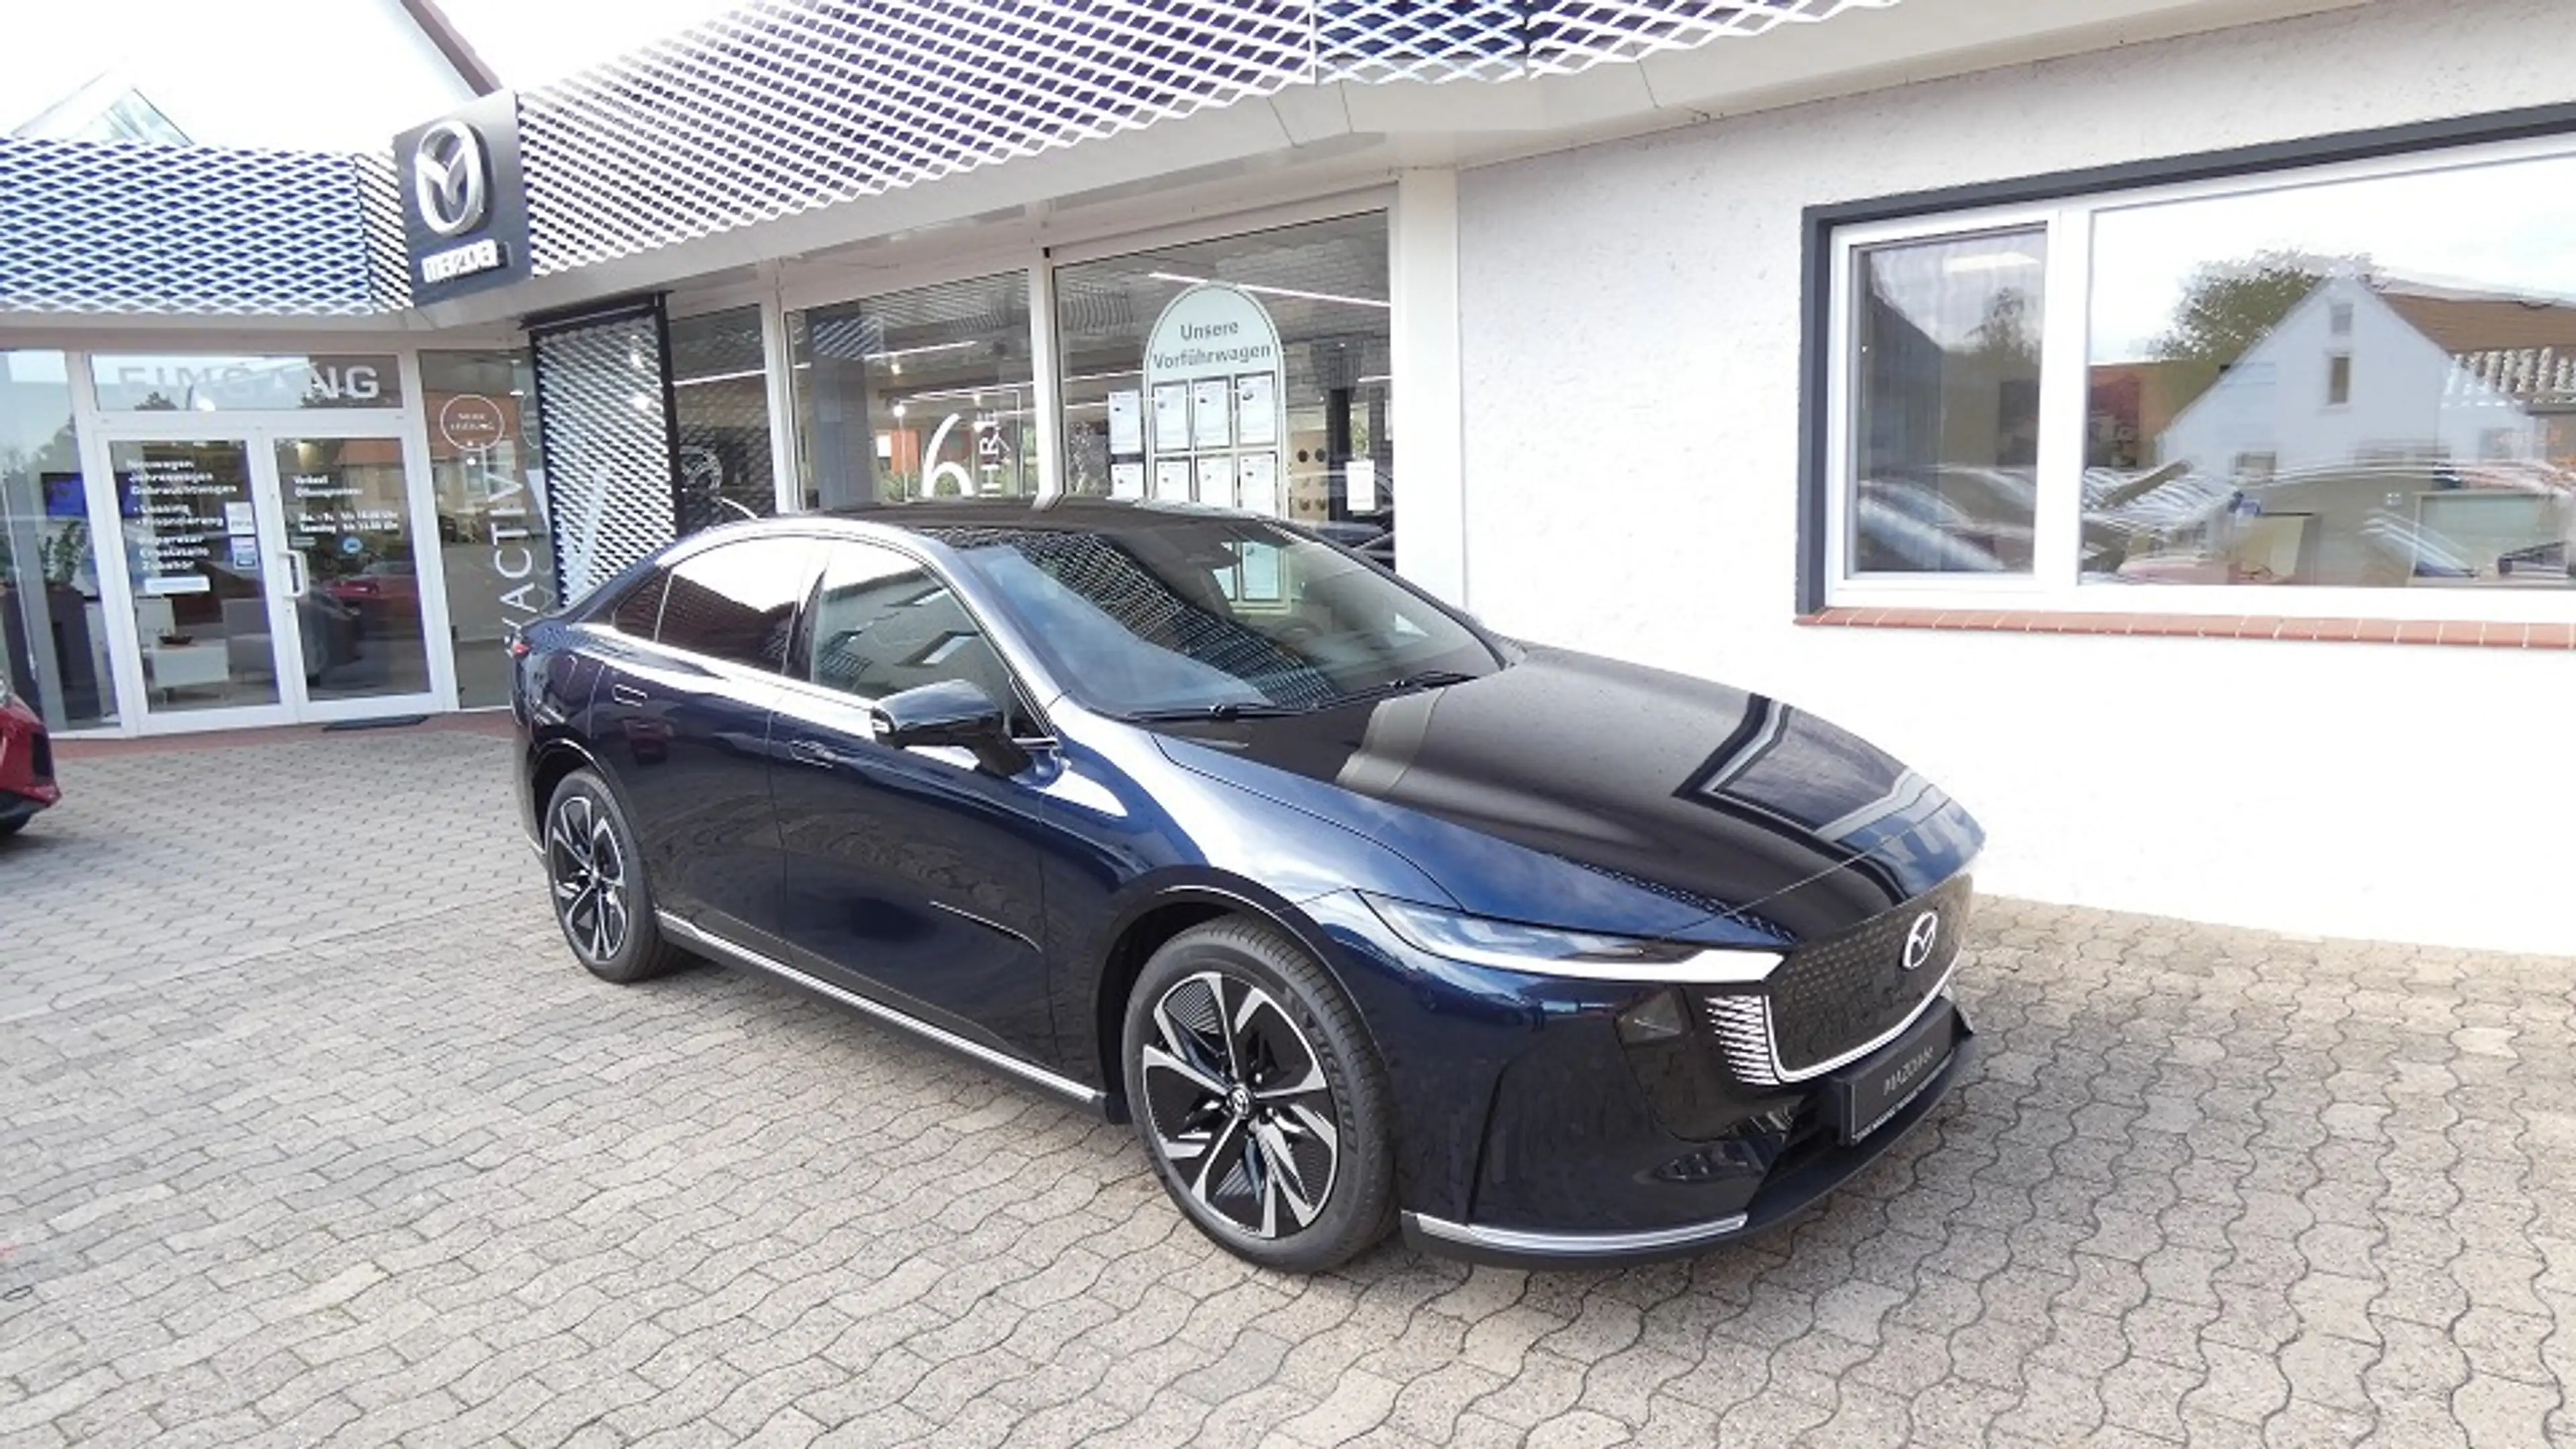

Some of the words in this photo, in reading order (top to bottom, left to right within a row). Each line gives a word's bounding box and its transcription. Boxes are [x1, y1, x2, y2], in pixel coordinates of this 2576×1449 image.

[1180, 322, 1239, 340] Unsere
[1153, 345, 1271, 368] Vorführwagen
[117, 365, 380, 400] EINGANG
